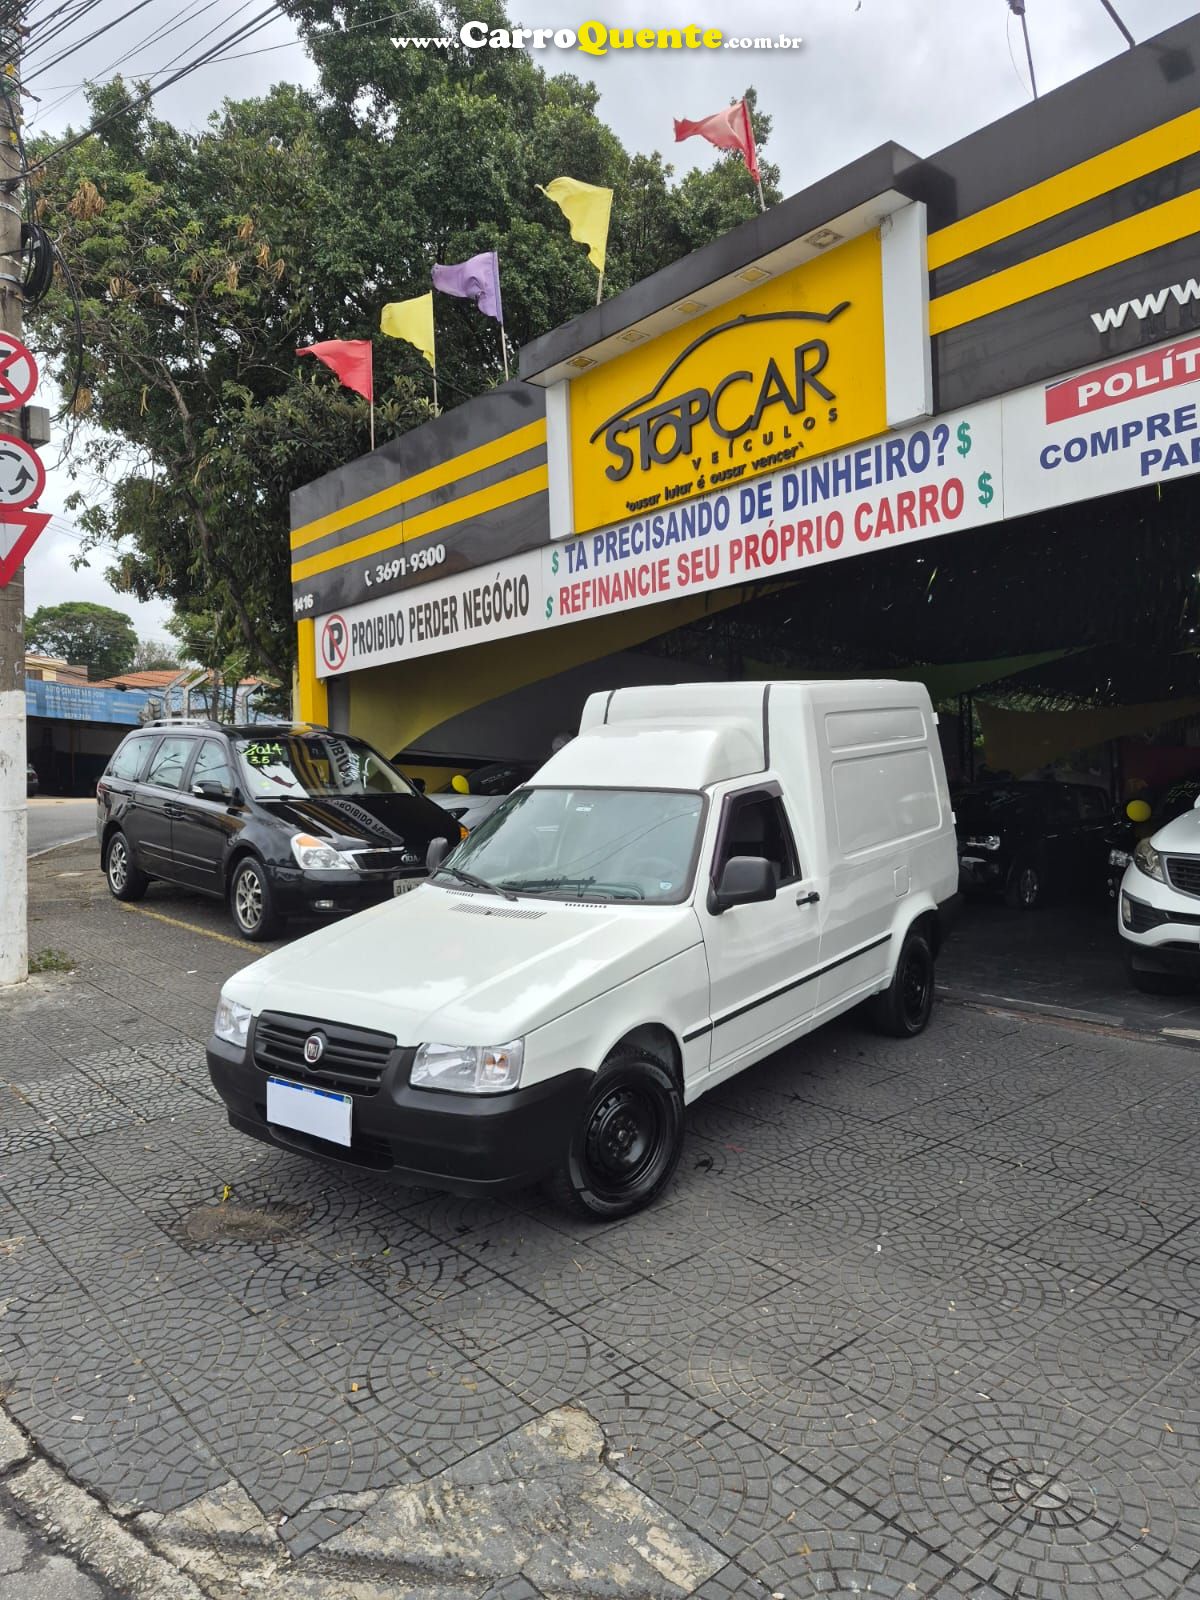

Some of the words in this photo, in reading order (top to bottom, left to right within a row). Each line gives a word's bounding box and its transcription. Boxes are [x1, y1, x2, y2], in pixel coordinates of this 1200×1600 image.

[1039, 403, 1198, 470] COMPRE
[565, 541, 589, 574] TA
[593, 496, 730, 566] PRECISANDO
[740, 480, 773, 525] DE
[782, 423, 950, 512] DINHEIRO?
[664, 480, 693, 501] lutar
[696, 475, 706, 490] é
[711, 462, 747, 484] ousar
[376, 543, 446, 584] 3691-9300
[559, 558, 671, 616] REFINANCIE
[677, 544, 720, 587] SEU
[729, 510, 844, 574] PRÓPRIO
[854, 478, 964, 542] CARRO
[352, 609, 405, 656] PROIBIDO
[408, 595, 459, 643] PERDER
[463, 572, 530, 630] NEGÓCIO
